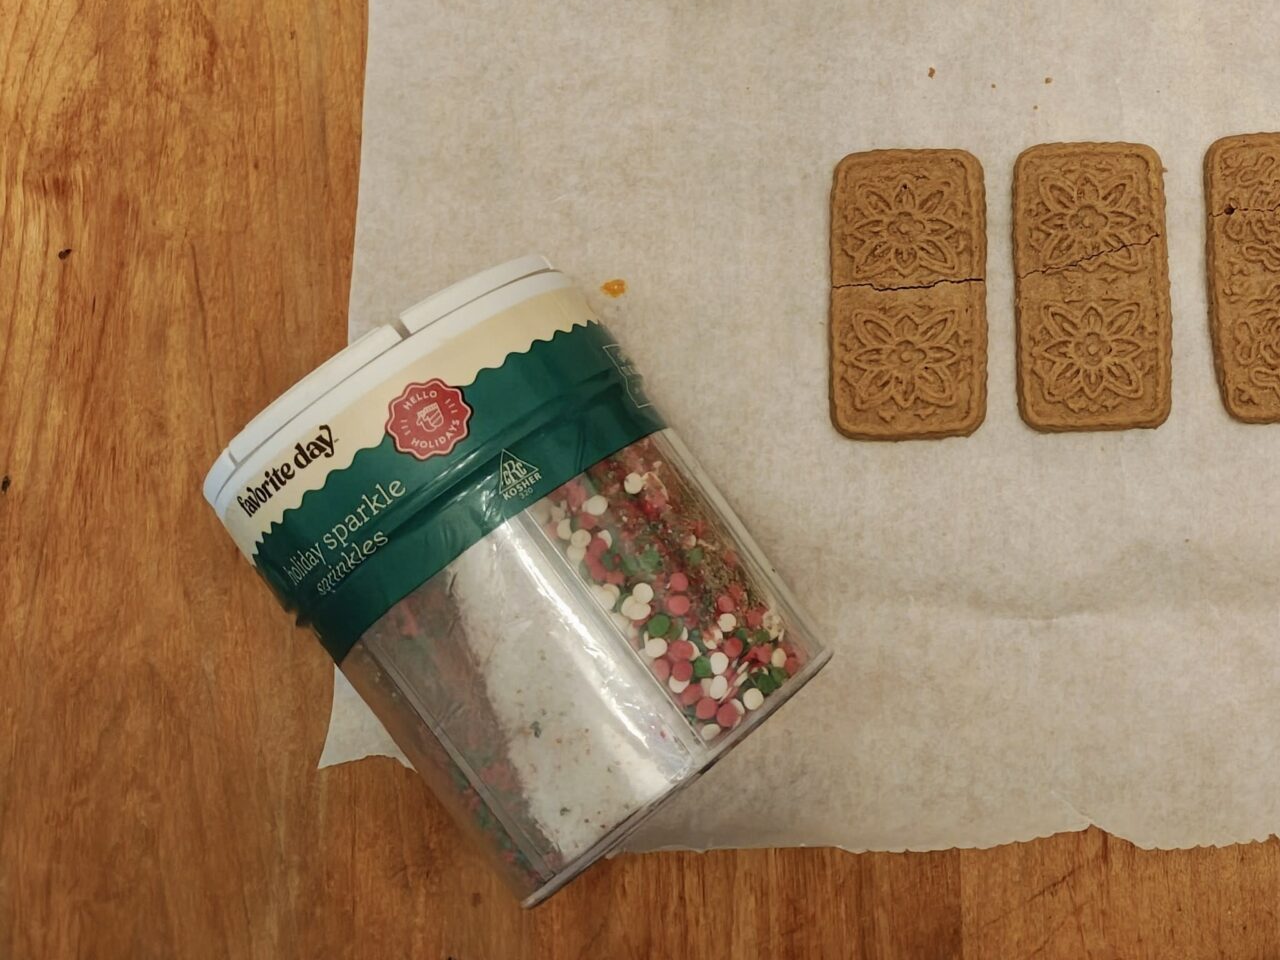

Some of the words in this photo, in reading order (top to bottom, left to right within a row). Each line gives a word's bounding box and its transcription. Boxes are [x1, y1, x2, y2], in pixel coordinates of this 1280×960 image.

[403, 390, 438, 410] HELLO
[411, 418, 460, 449] HOLIDAYS
[236, 462, 296, 518] favorite
[502, 472, 542, 501] KOSHER
[519, 487, 534, 500] 320
[282, 542, 327, 586] holiday
[323, 479, 407, 551] sparkle
